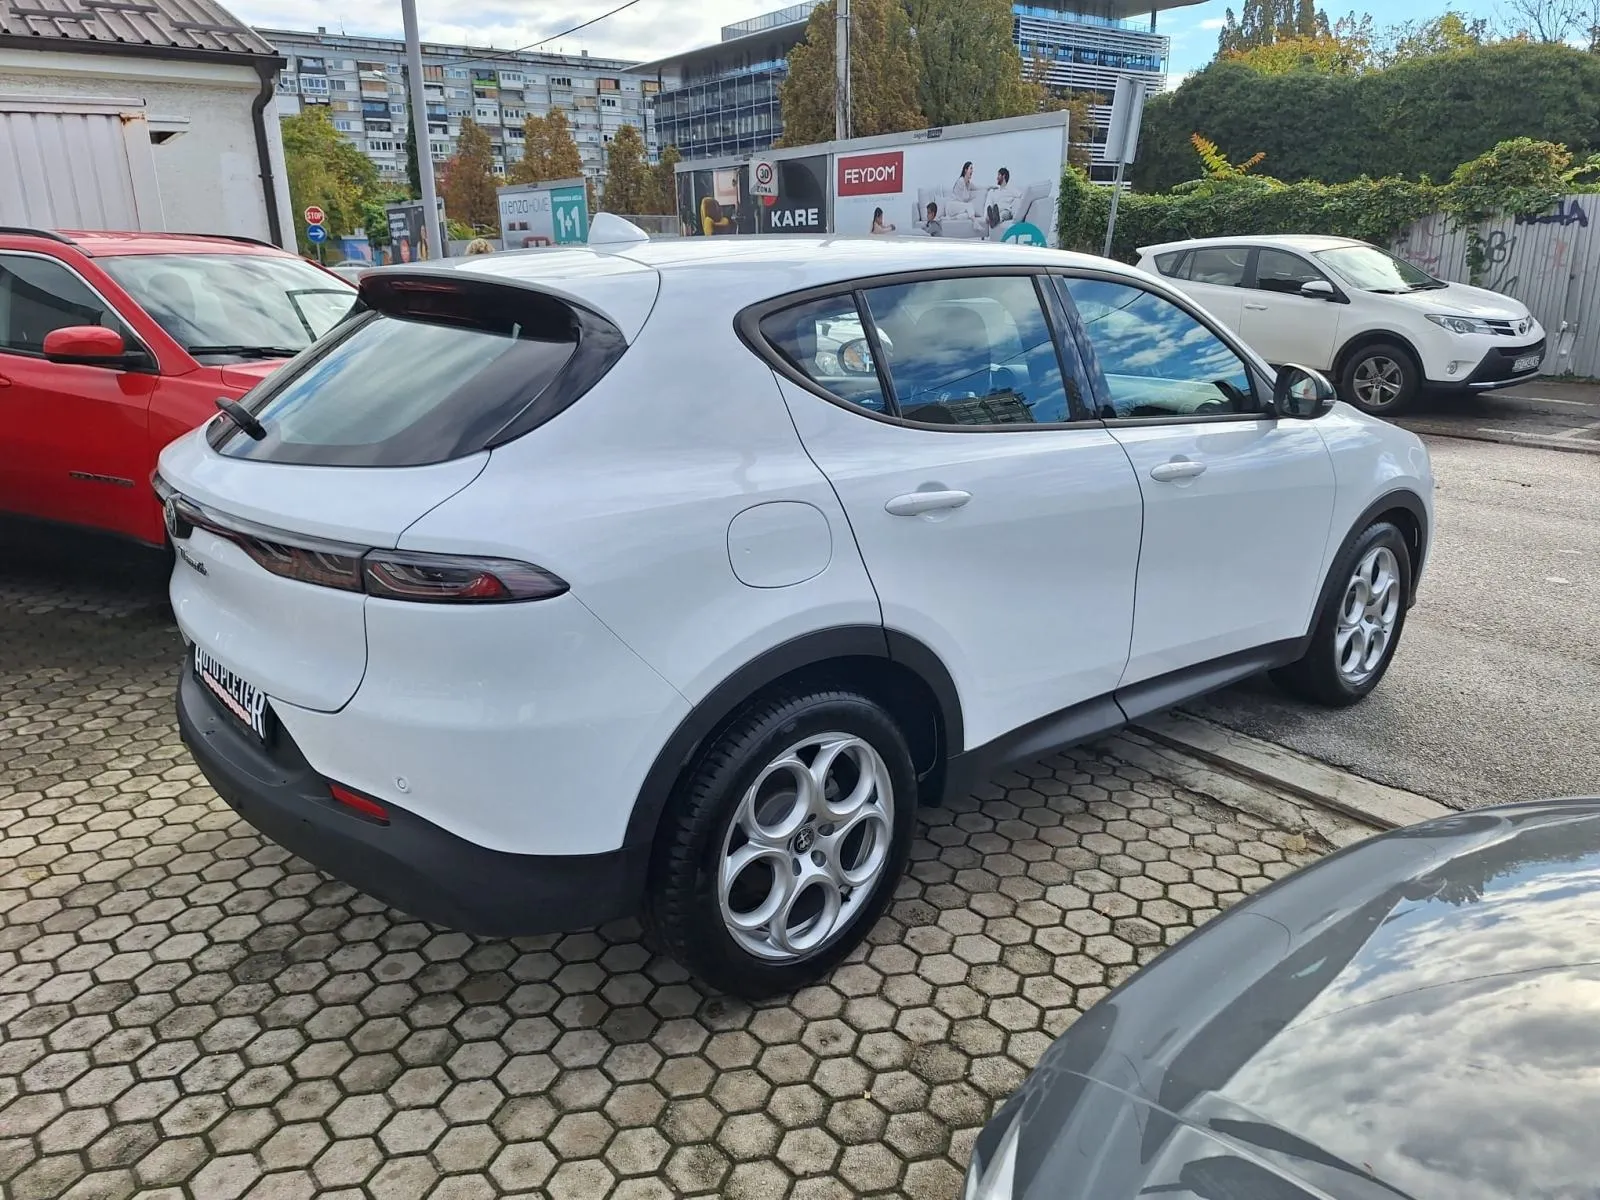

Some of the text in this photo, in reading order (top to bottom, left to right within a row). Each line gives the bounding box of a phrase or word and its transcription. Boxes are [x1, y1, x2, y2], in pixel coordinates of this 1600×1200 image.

[759, 168, 769, 179] 30
[844, 165, 896, 184] FEYDOM
[756, 185, 772, 193] ZONA
[307, 212, 322, 220] STOP
[771, 208, 818, 228] KARE
